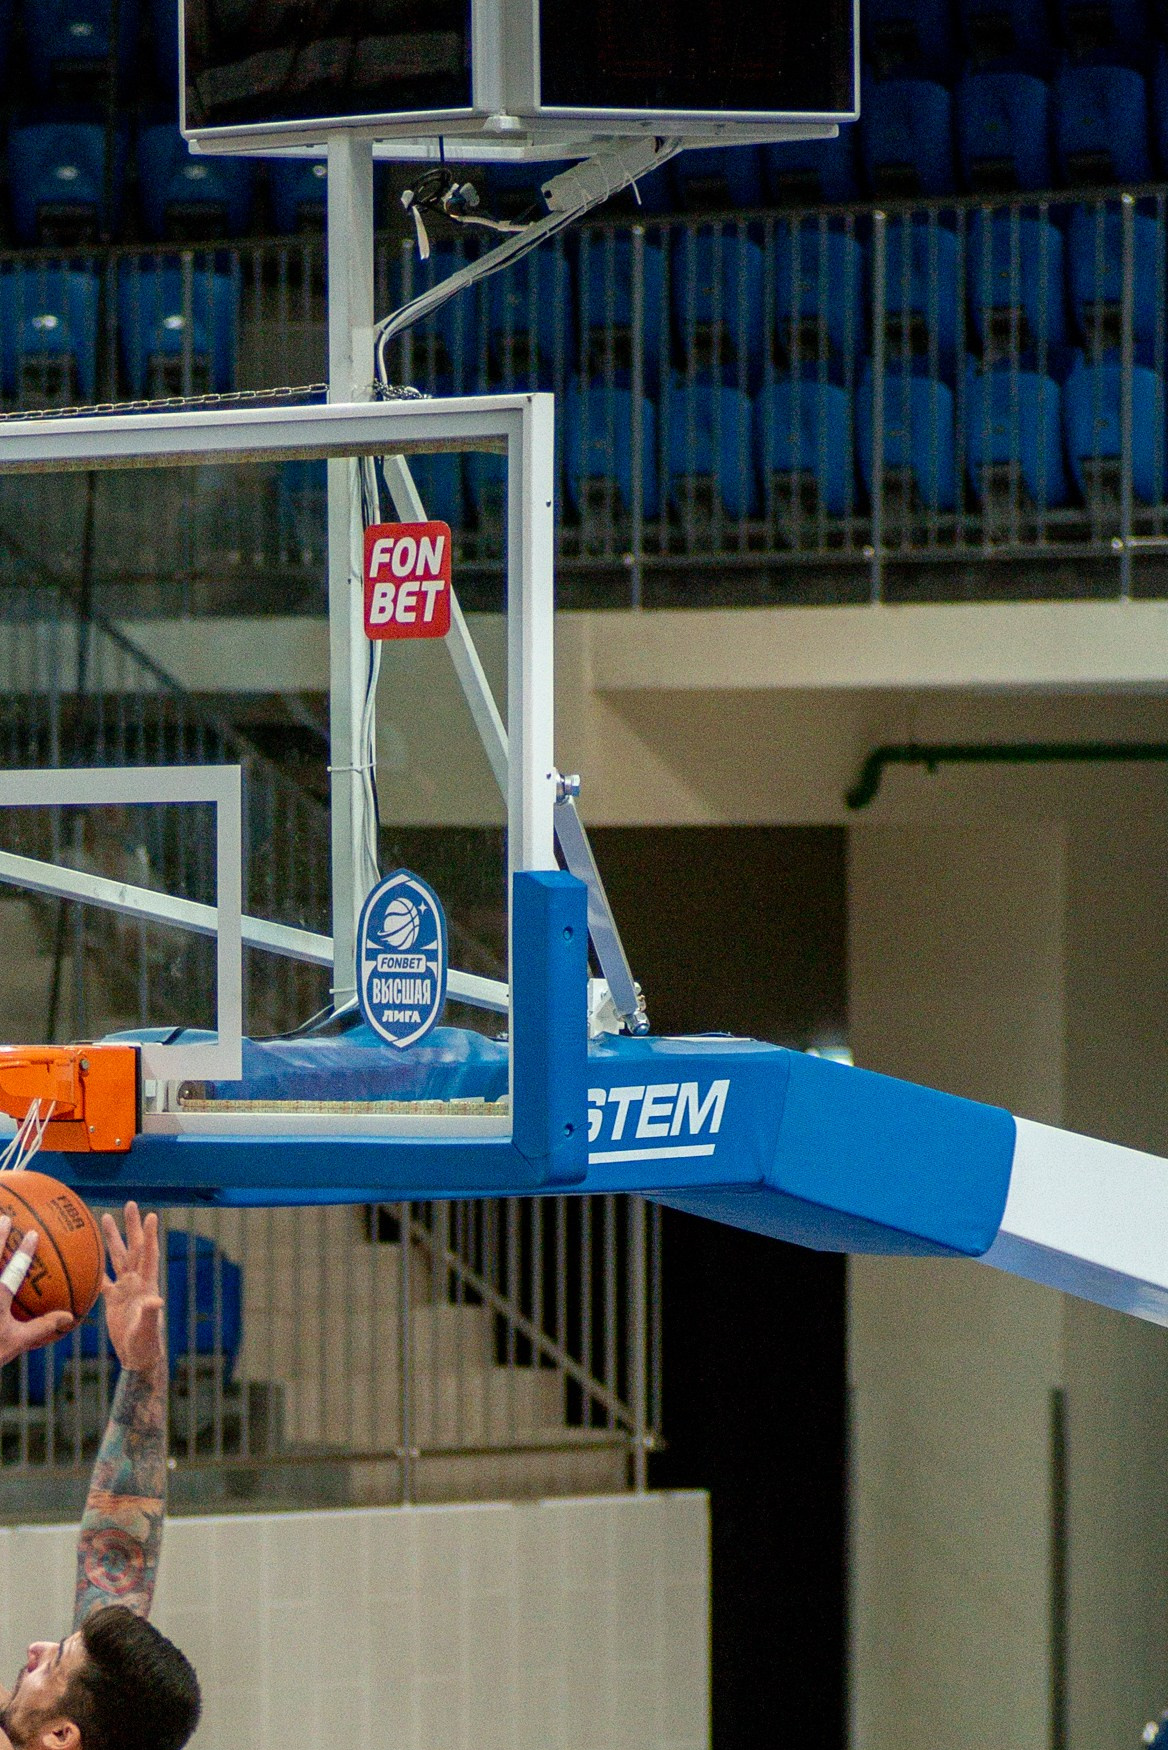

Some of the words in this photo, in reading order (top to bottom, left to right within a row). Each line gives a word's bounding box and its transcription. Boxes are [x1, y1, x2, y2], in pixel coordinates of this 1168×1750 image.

[369, 535, 445, 578] FON
[369, 580, 445, 624] BET
[380, 957, 423, 970] FONBET
[372, 978, 431, 1005] ВЫСШАЯ
[382, 1009, 422, 1023] ЛИГА
